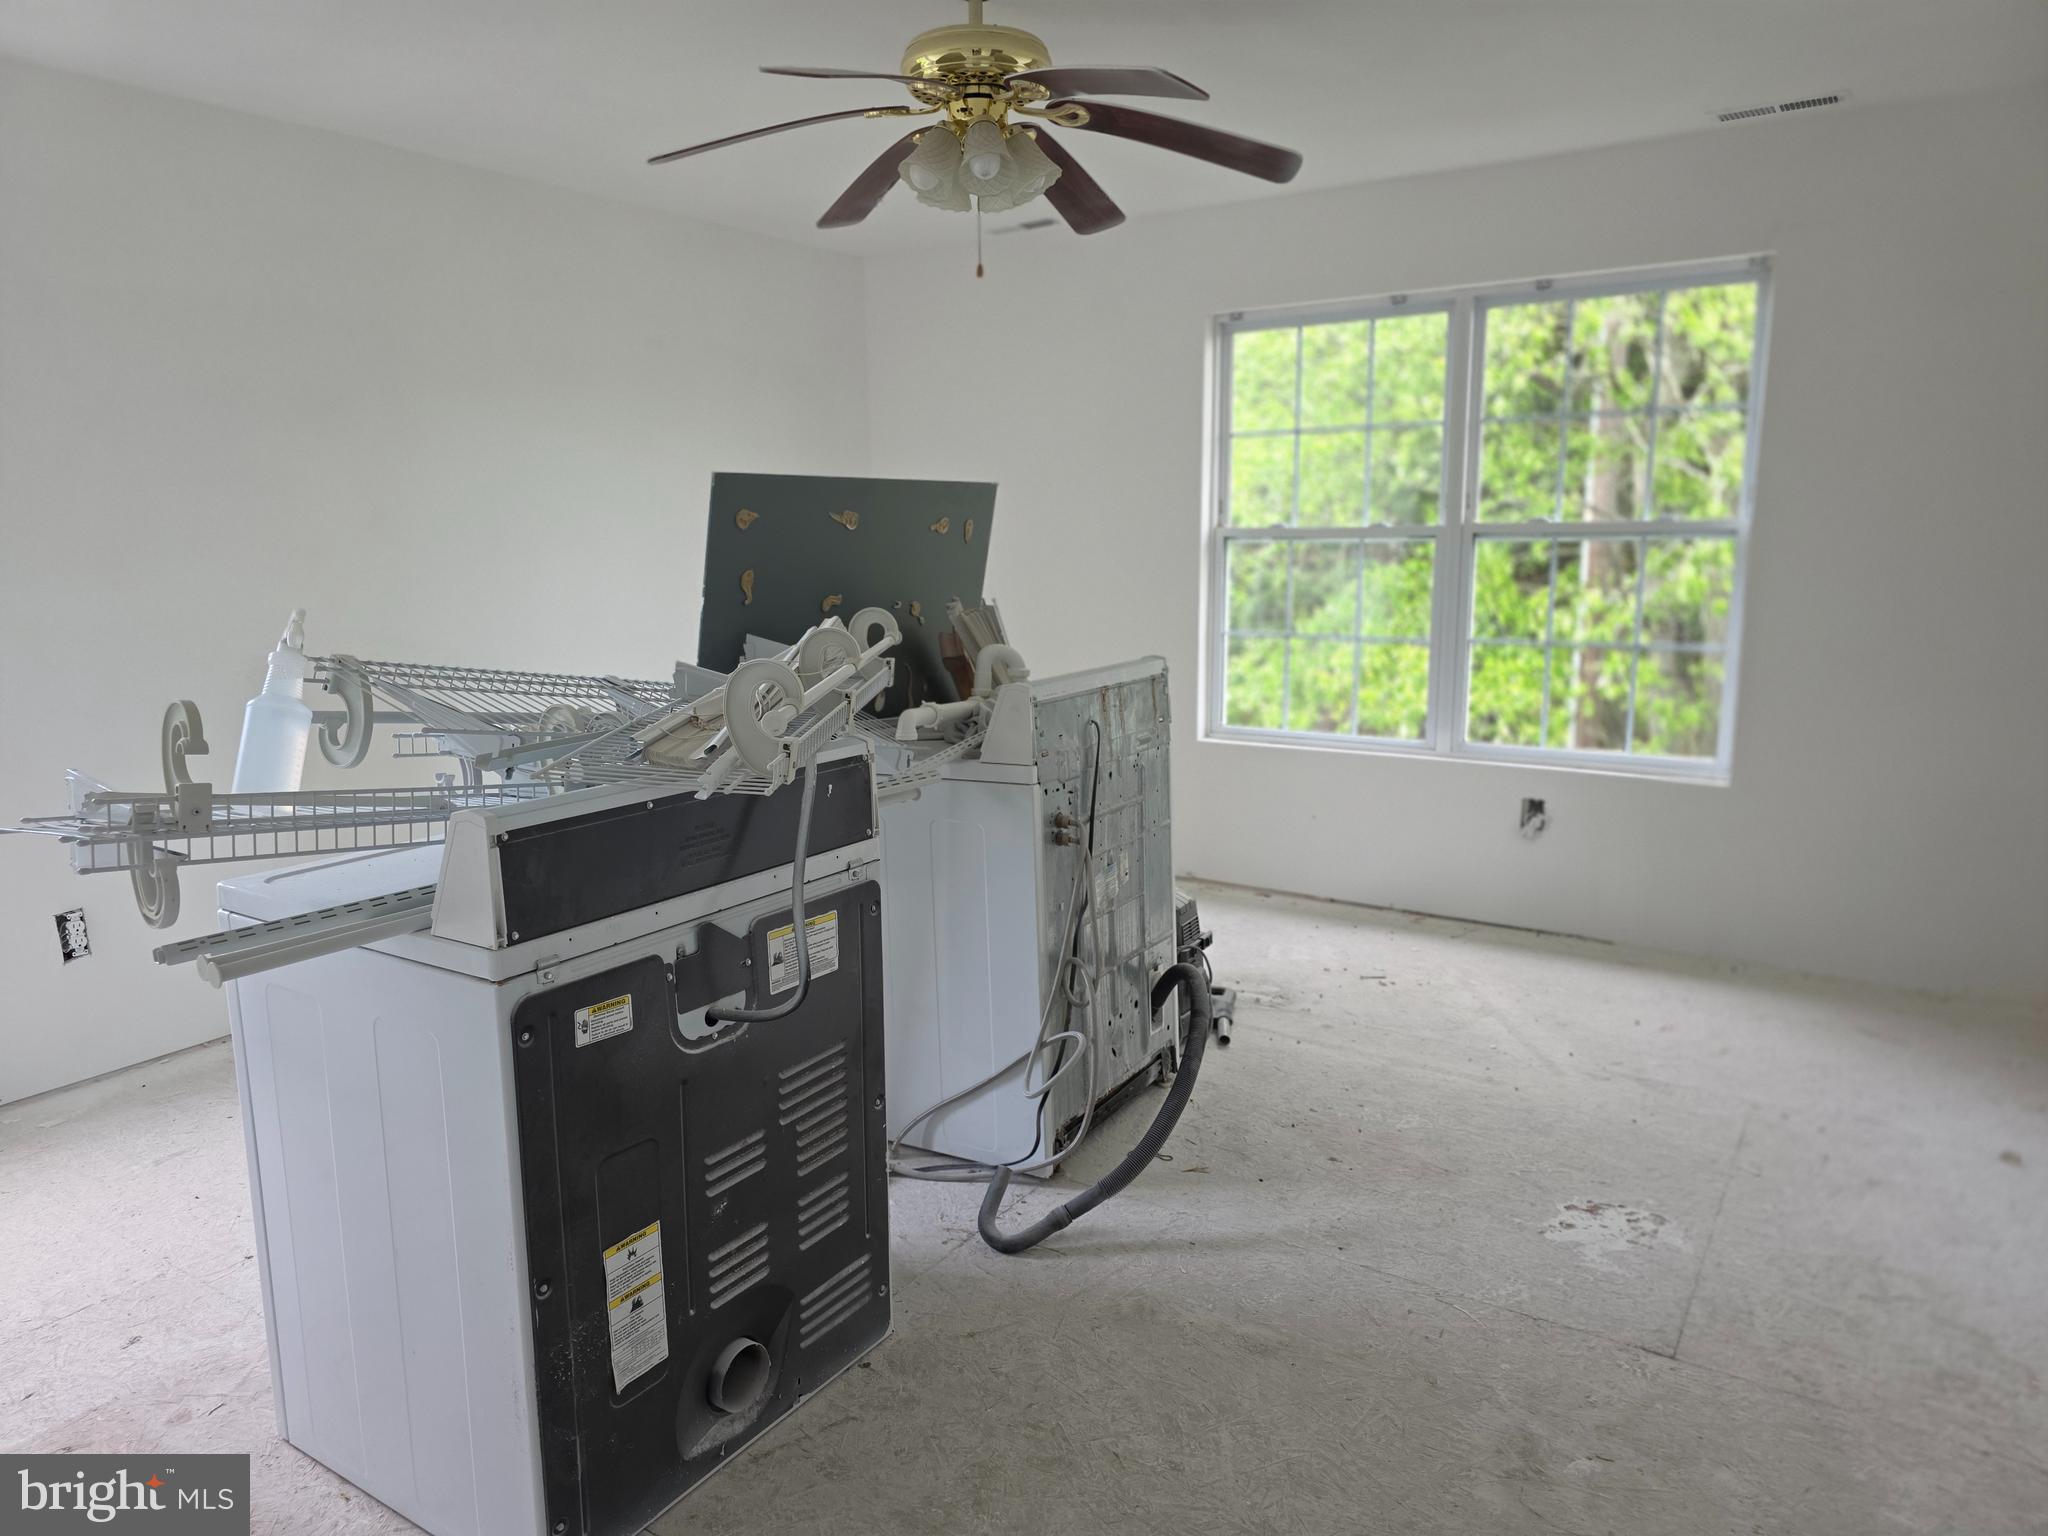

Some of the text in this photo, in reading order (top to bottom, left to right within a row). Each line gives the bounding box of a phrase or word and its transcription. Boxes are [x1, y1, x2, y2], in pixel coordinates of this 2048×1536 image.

[596, 998, 626, 1011] WARNING
[620, 1231, 647, 1249] WARNING
[624, 1280, 651, 1299] WARNING
